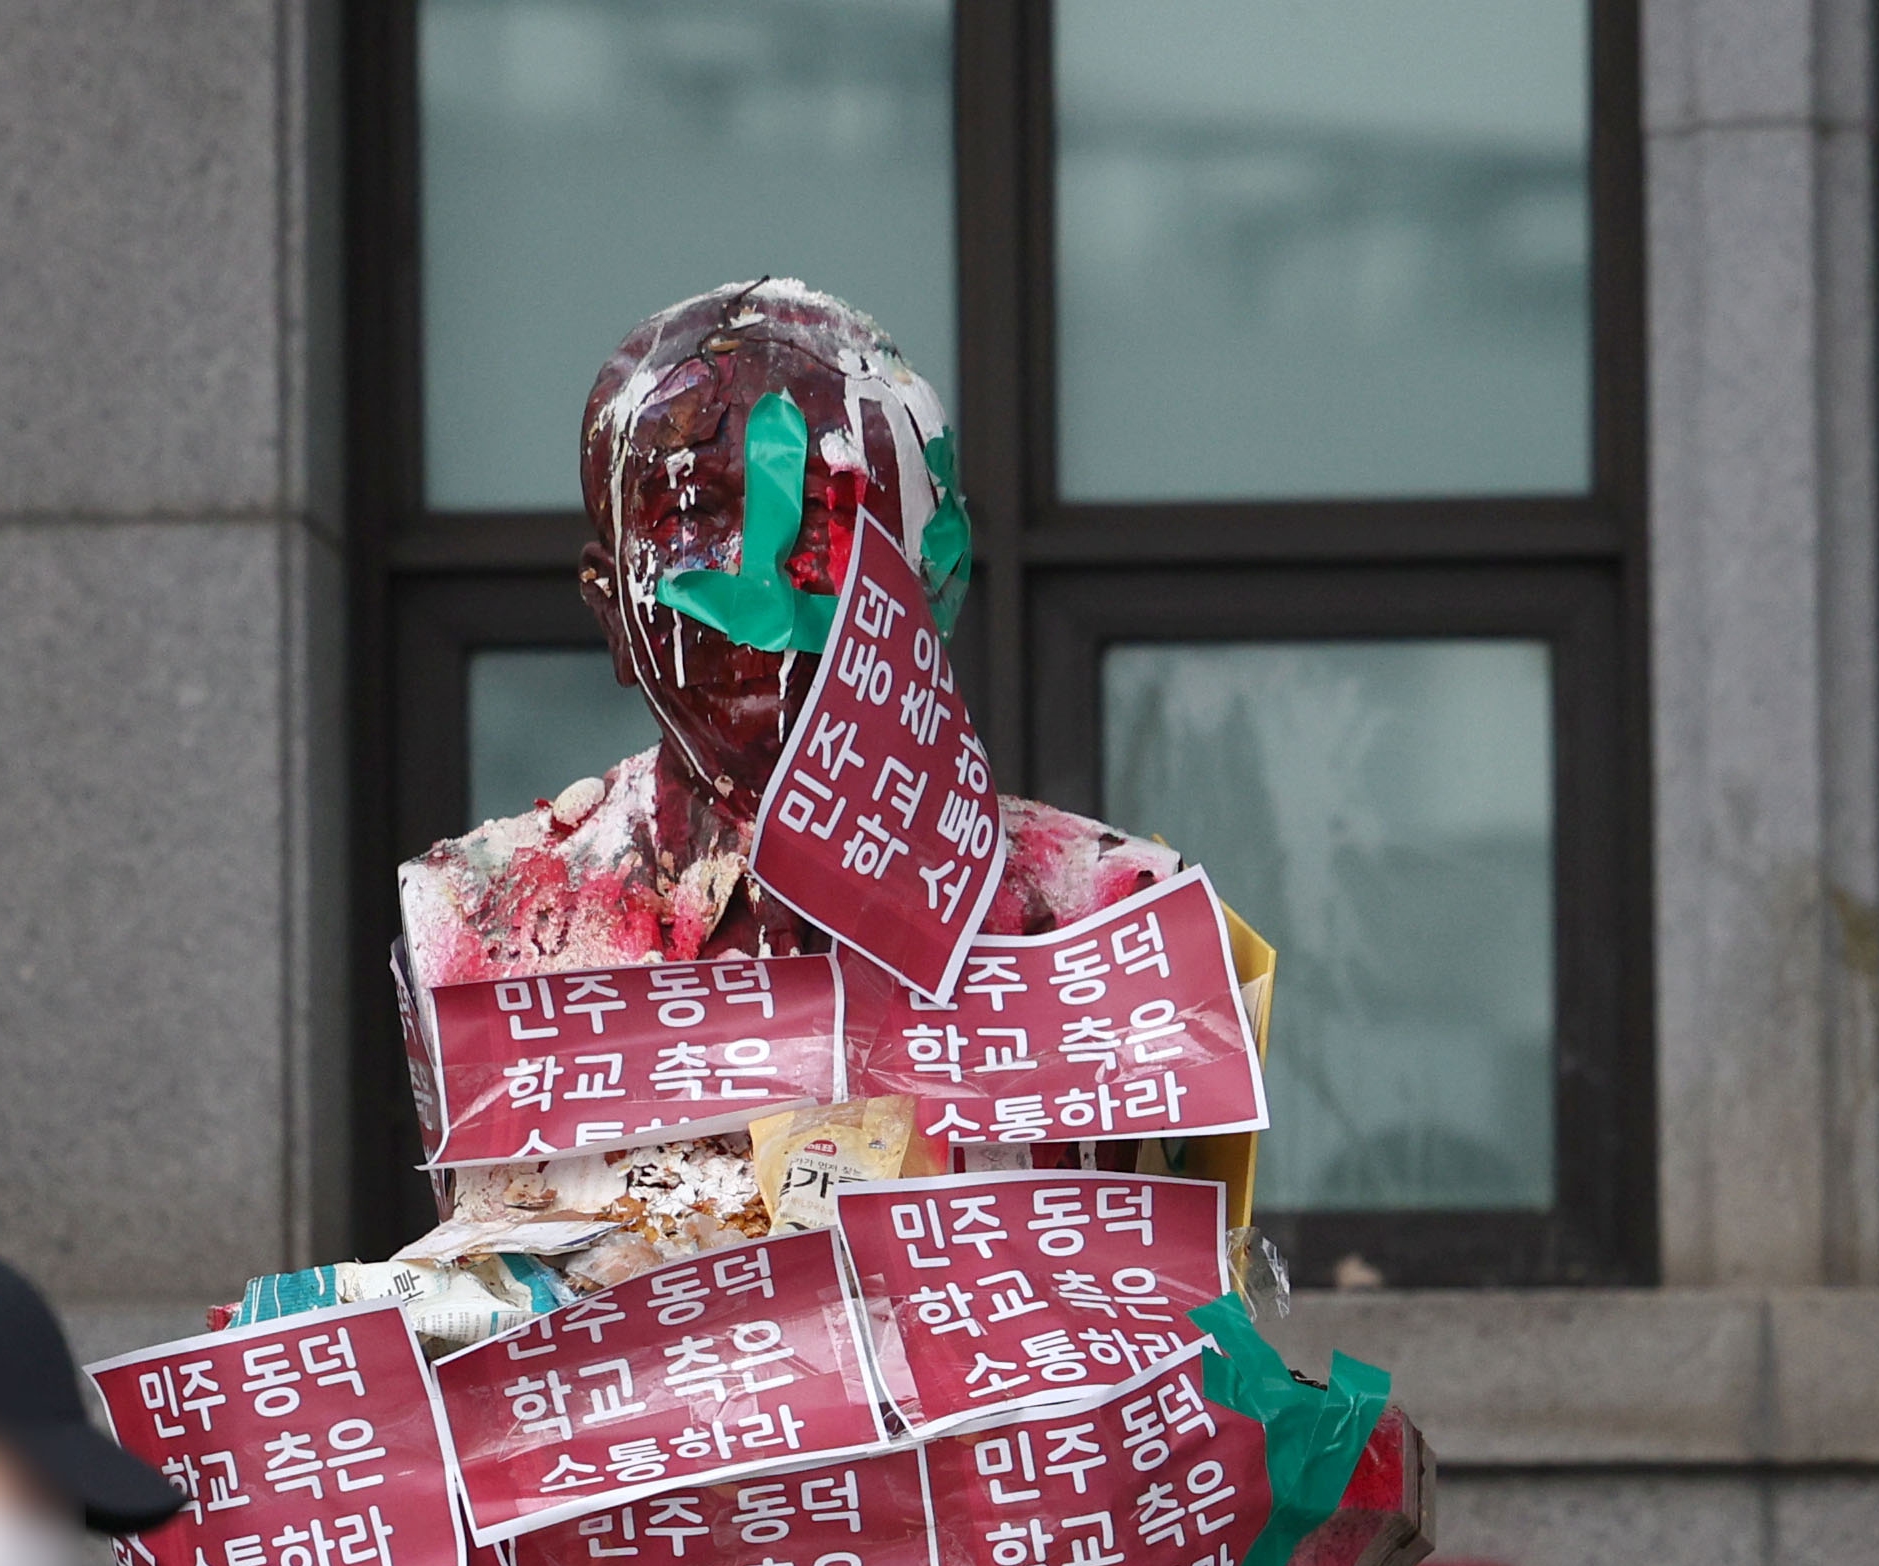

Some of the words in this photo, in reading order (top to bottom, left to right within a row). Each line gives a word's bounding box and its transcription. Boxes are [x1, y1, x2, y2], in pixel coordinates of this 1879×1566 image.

[778, 712, 865, 840] 민주
[838, 576, 905, 705] 동덕
[843, 756, 928, 879] 학교
[900, 628, 953, 745] 측은
[919, 709, 988, 923] 소통하
[495, 973, 627, 1040] 민주
[647, 961, 774, 1028] 동덕
[910, 955, 1027, 1012] 주
[1049, 911, 1170, 1005] 동덕
[503, 1052, 626, 1112] 학교
[649, 1038, 778, 1100] 측은
[902, 1023, 1038, 1083] 학교
[1058, 998, 1186, 1071] 측은
[925, 1071, 1188, 1144] 소통하라
[891, 1194, 1008, 1268] 민주
[1027, 1185, 1153, 1257] 동덕
[648, 1247, 775, 1325] 동덕
[910, 1268, 1048, 1338] 학교
[1051, 1266, 1175, 1322] 측은
[139, 1361, 226, 1438] 민주
[242, 1327, 365, 1417] 동덕
[504, 1357, 647, 1440] 학교
[664, 1320, 794, 1396] 측은
[265, 1418, 386, 1499] 측은
[540, 1404, 805, 1493] 소통하라
[973, 1422, 1107, 1505] 민주
[1121, 1372, 1216, 1473] 동덕
[578, 1497, 709, 1558] 민주
[732, 1470, 862, 1544] 동덕
[1137, 1460, 1235, 1548] 측은
